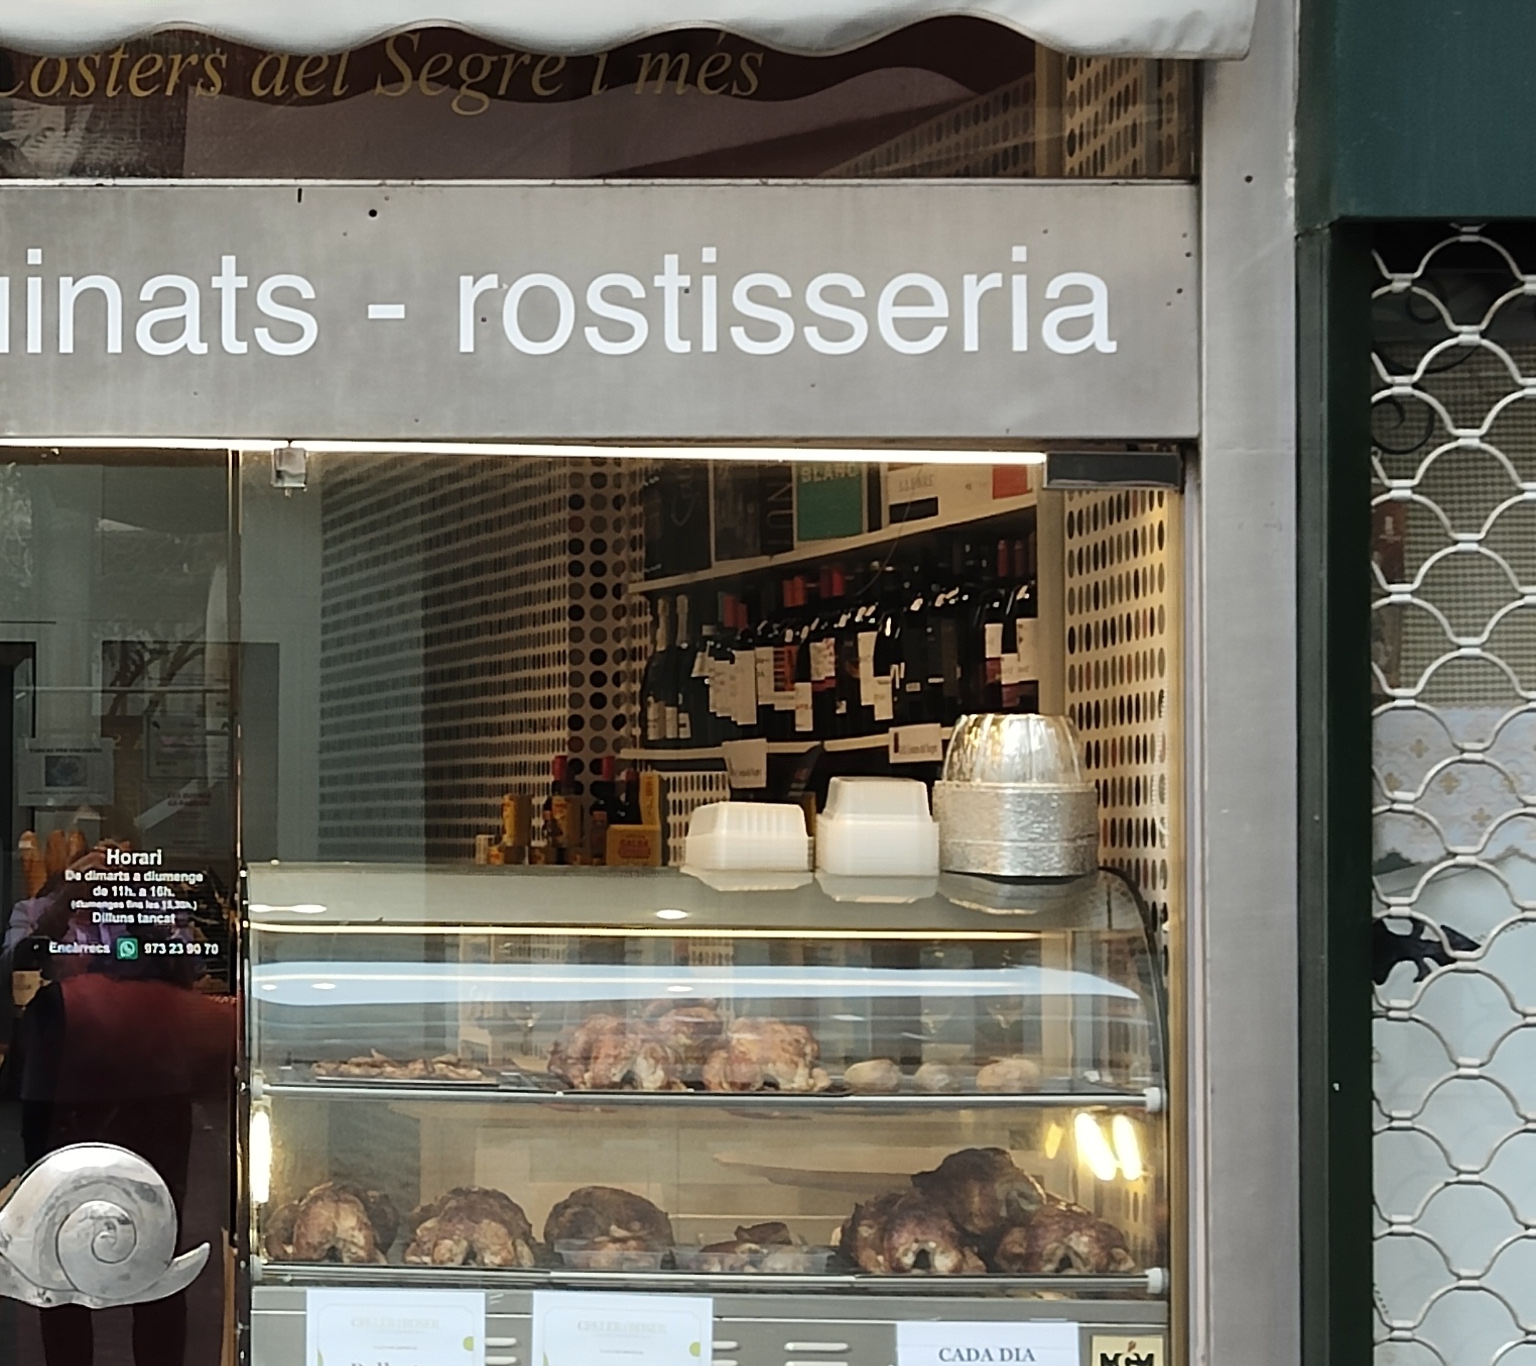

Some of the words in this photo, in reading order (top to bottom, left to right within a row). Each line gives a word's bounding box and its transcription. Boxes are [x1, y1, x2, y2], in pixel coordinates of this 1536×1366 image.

[375, 33, 566, 116] Segre
[458, 245, 1117, 356] rostisseria
[106, 848, 162, 866] Horari
[65, 870, 82, 881] De
[84, 869, 130, 882] dimarts
[143, 870, 204, 885] diumenge
[93, 886, 108, 897] de
[92, 912, 135, 924] Dilluns
[137, 913, 176, 924] tancat
[144, 942, 167, 955] 973
[168, 942, 184, 955] 23
[938, 1347, 994, 1363] CADA
[999, 1347, 1037, 1363] DIA
